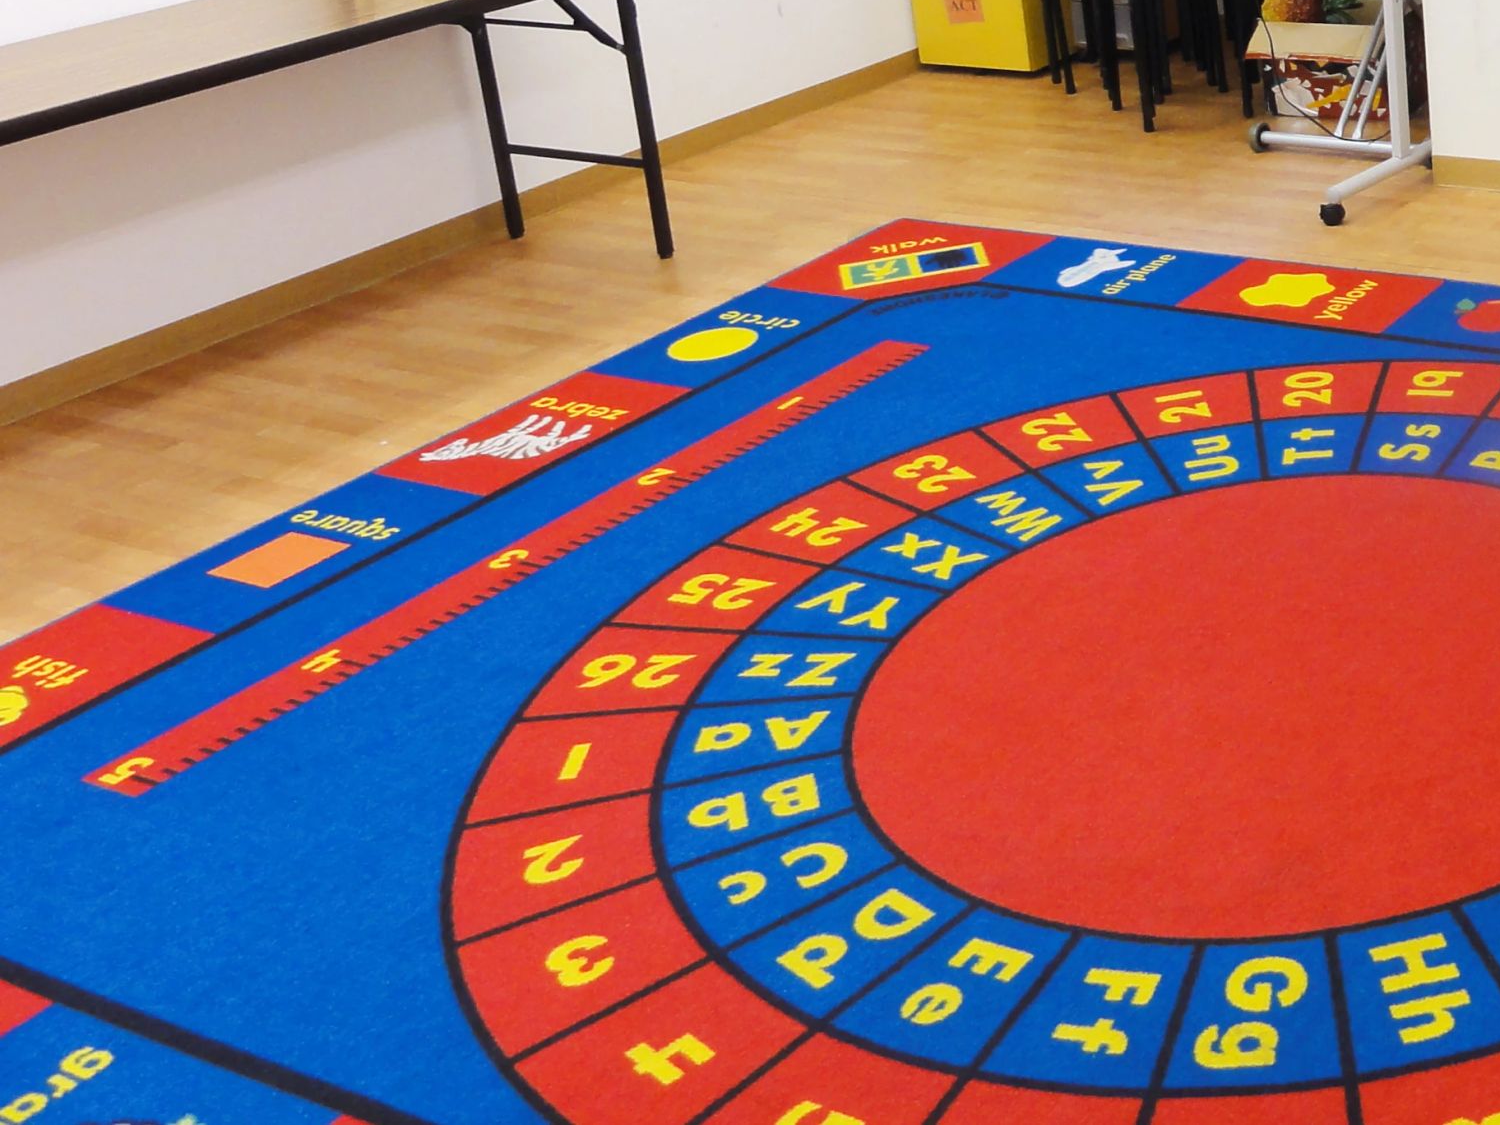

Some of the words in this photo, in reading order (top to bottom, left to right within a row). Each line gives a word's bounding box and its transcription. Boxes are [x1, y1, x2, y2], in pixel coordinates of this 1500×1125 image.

[870, 235, 948, 256] walk
[1313, 278, 1380, 321] yellow
[718, 310, 801, 331] circle
[1282, 370, 1335, 408] 20
[1406, 370, 1464, 397] 19
[530, 396, 629, 421] zebra
[1154, 390, 1213, 424] 21
[1021, 411, 1093, 452] 22
[636, 467, 675, 486] 2
[892, 454, 977, 494] 23
[291, 509, 401, 542] square
[769, 507, 868, 547] 24
[487, 549, 529, 570] 3
[666, 573, 777, 611] 25
[12, 654, 90, 689] fish
[300, 648, 341, 674] 4
[578, 653, 697, 690] 26
[97, 756, 155, 786] 5
[522, 834, 584, 885] 2
[544, 934, 615, 988] 3
[624, 1033, 716, 1086] 4
[0, 1046, 116, 1125] gra
